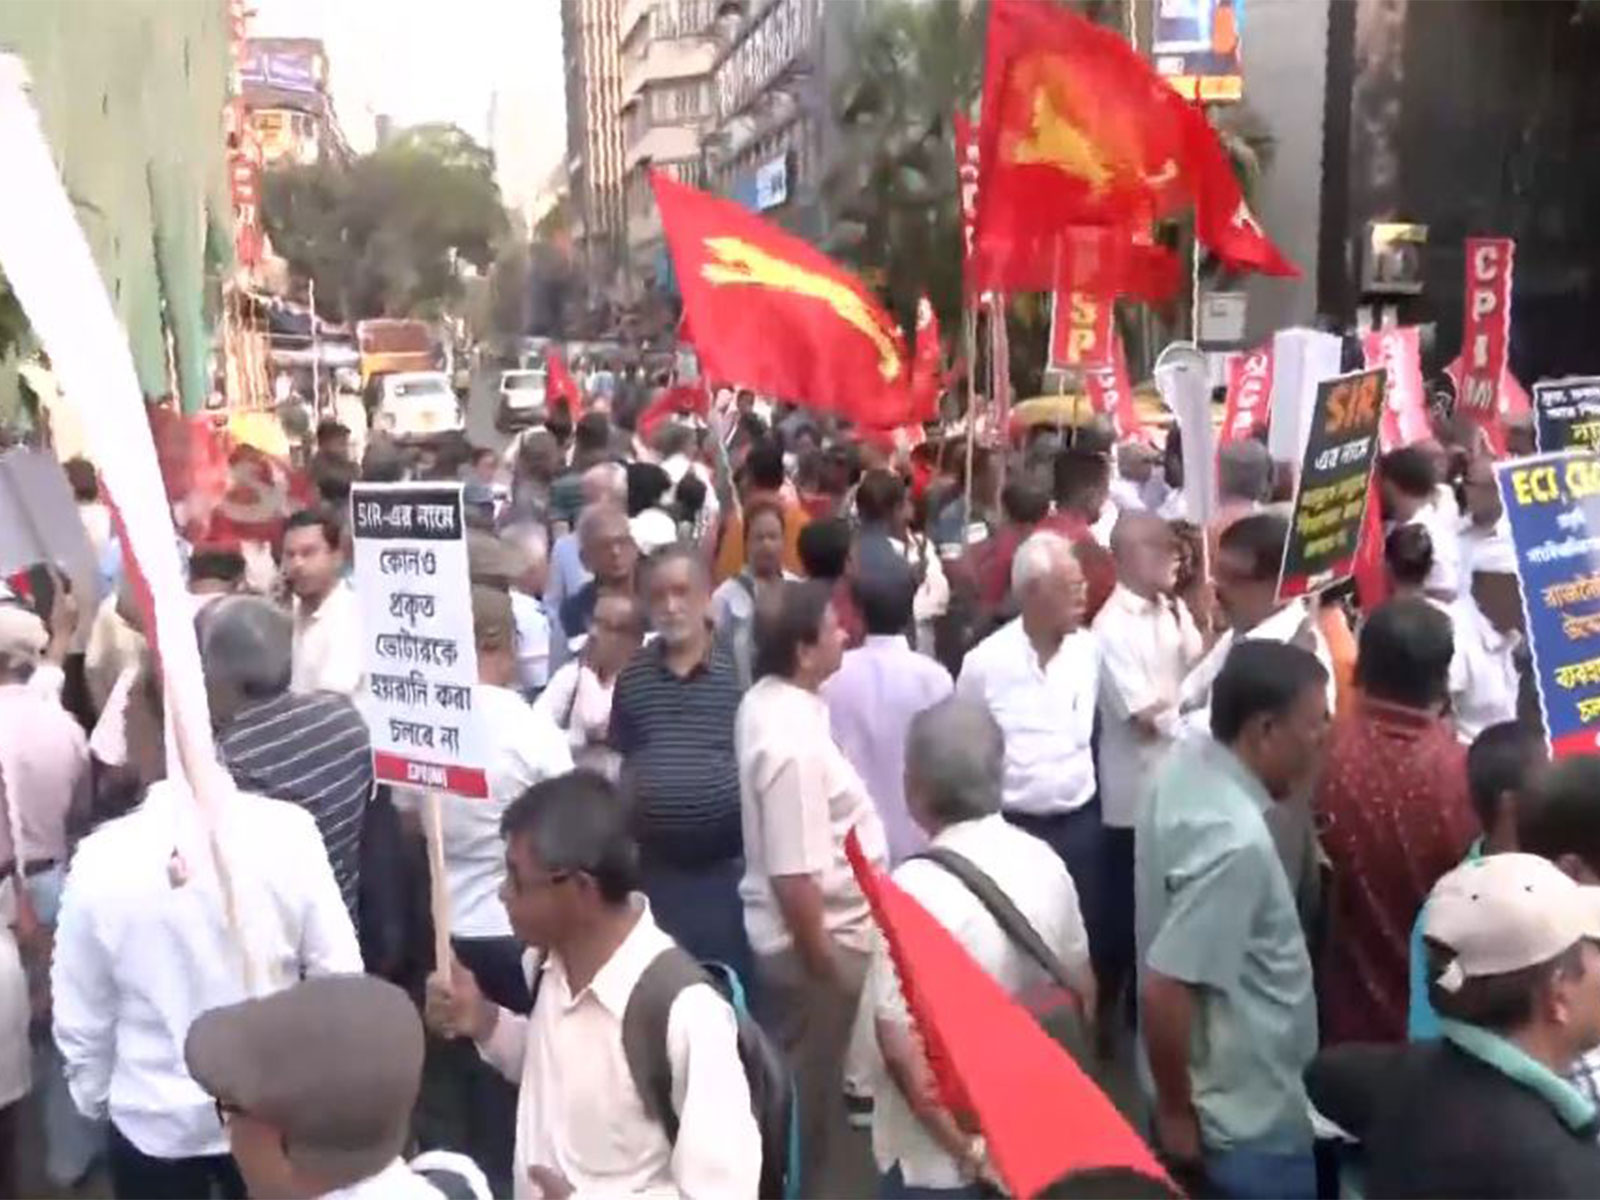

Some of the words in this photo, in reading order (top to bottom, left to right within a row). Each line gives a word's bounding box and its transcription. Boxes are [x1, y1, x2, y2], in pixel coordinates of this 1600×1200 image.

[358, 502, 412, 529] SIR-এর
[416, 504, 454, 531] নামে
[376, 627, 459, 667] ভোটারকে
[434, 683, 472, 711] করা
[389, 717, 435, 748] চলবে
[439, 725, 460, 756] না
